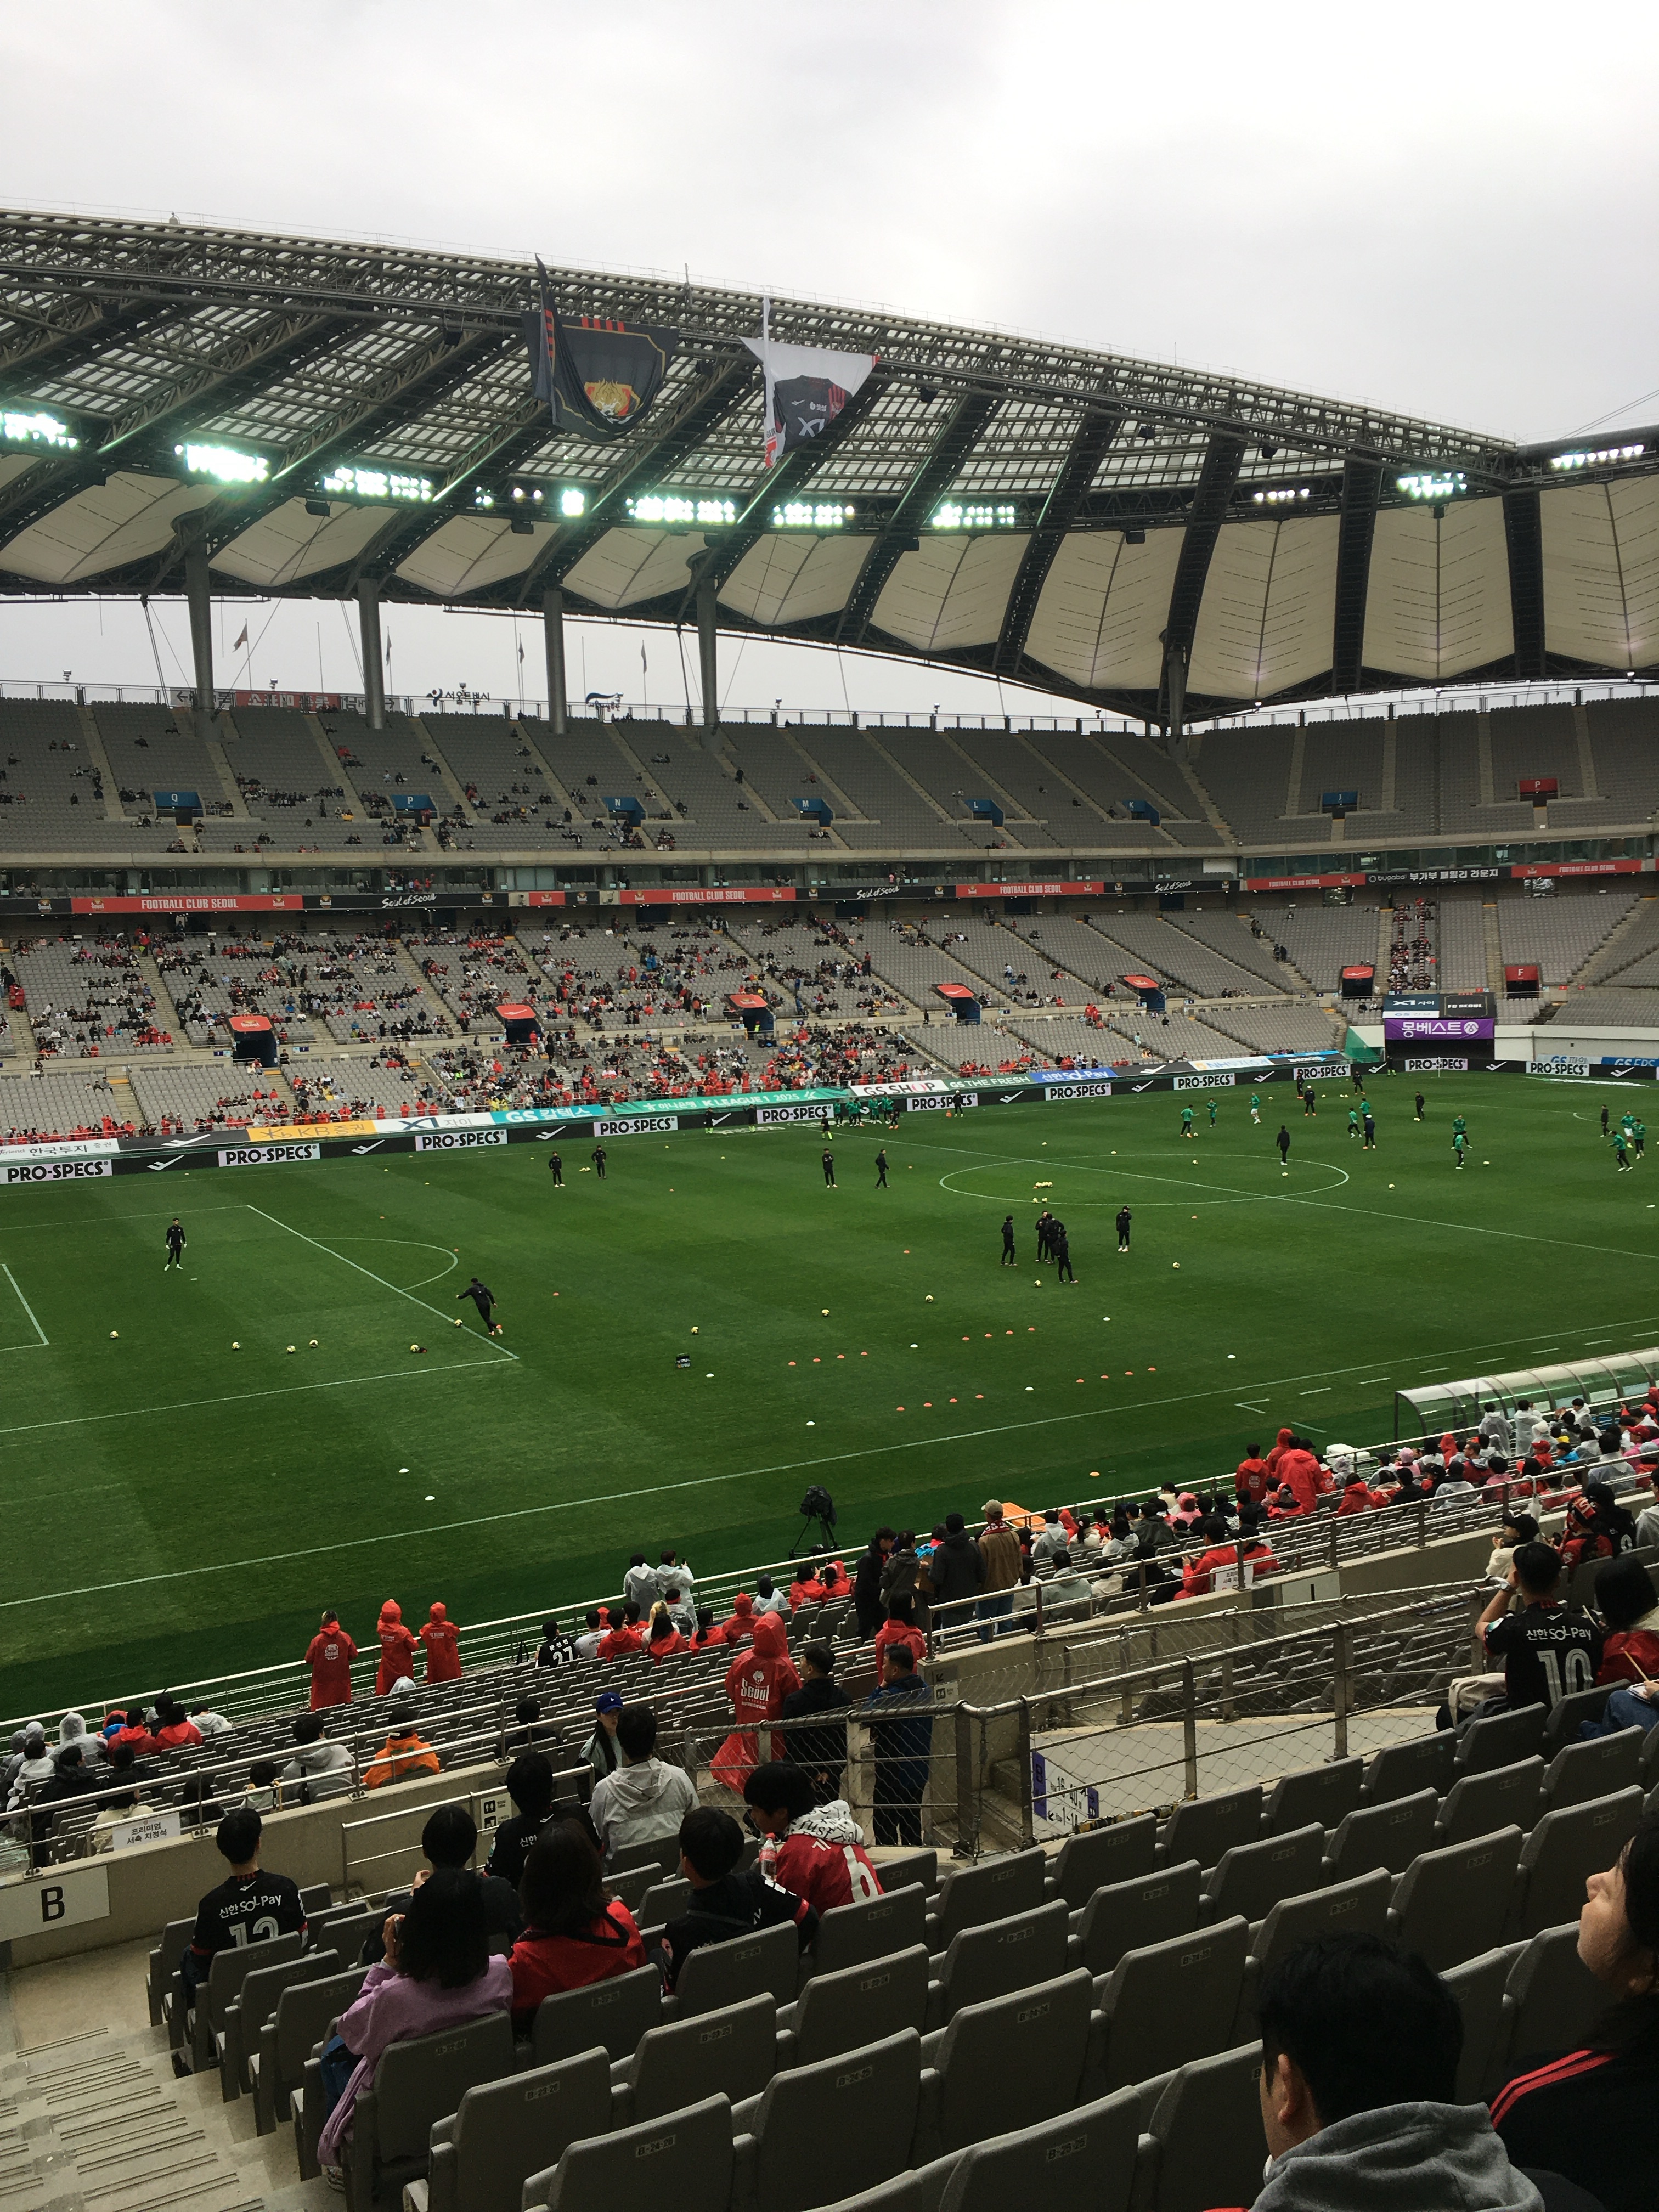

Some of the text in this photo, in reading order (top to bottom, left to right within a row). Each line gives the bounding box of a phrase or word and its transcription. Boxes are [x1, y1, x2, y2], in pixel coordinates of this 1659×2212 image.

[171, 793, 178, 802] Q
[407, 796, 414, 805] P
[1410, 872, 1437, 881] 부가부
[1470, 868, 1498, 878] 라운지
[673, 890, 746, 900] FOOTBALL CLUB SEOUL
[1000, 885, 1062, 894] FOOTBALL CLUB SEOUL
[141, 898, 239, 909] FOOTBALL CLUB SEOUL
[1402, 1022, 1463, 1038] 몽베스트
[1409, 1059, 1463, 1070] PRO-SPECS
[1531, 1063, 1584, 1075] PRO-SPECS
[990, 1076, 1031, 1085] FRESH
[1084, 1070, 1108, 1079] Pay
[1178, 1074, 1231, 1089] PRO-SPECS
[864, 1082, 935, 1096] GS SHOP
[1050, 1084, 1106, 1099] PRO-SPECS
[718, 1095, 763, 1105] LEAGUE
[773, 1092, 801, 1102] 2025
[912, 1093, 972, 1110] PRO-SPCS
[506, 1107, 592, 1122] GS 칼텍스
[763, 1105, 828, 1122] PRO-SPECS
[444, 1118, 472, 1127] 자이
[600, 1118, 672, 1135] PRO-SPECS
[298, 1124, 365, 1137] KB 증권
[422, 1131, 500, 1149] PRO-SPECS
[29, 1144, 89, 1156] 한국투자
[225, 1145, 312, 1165] PRO-SPECS
[7, 1161, 104, 1182] PRO-SPECS
[1526, 1625, 1592, 1641] 신한 SOL Pay
[553, 1646, 573, 1666] 27
[1537, 1648, 1594, 1706] 10
[741, 1678, 770, 1702] Seoul
[132, 1822, 161, 1836] 프리미엄
[144, 1829, 167, 1839] 지정석
[520, 1835, 538, 1847] 신한
[842, 1844, 879, 1903] 6
[41, 1886, 66, 1923] B
[219, 1895, 282, 1919] 신한 SOL Pay
